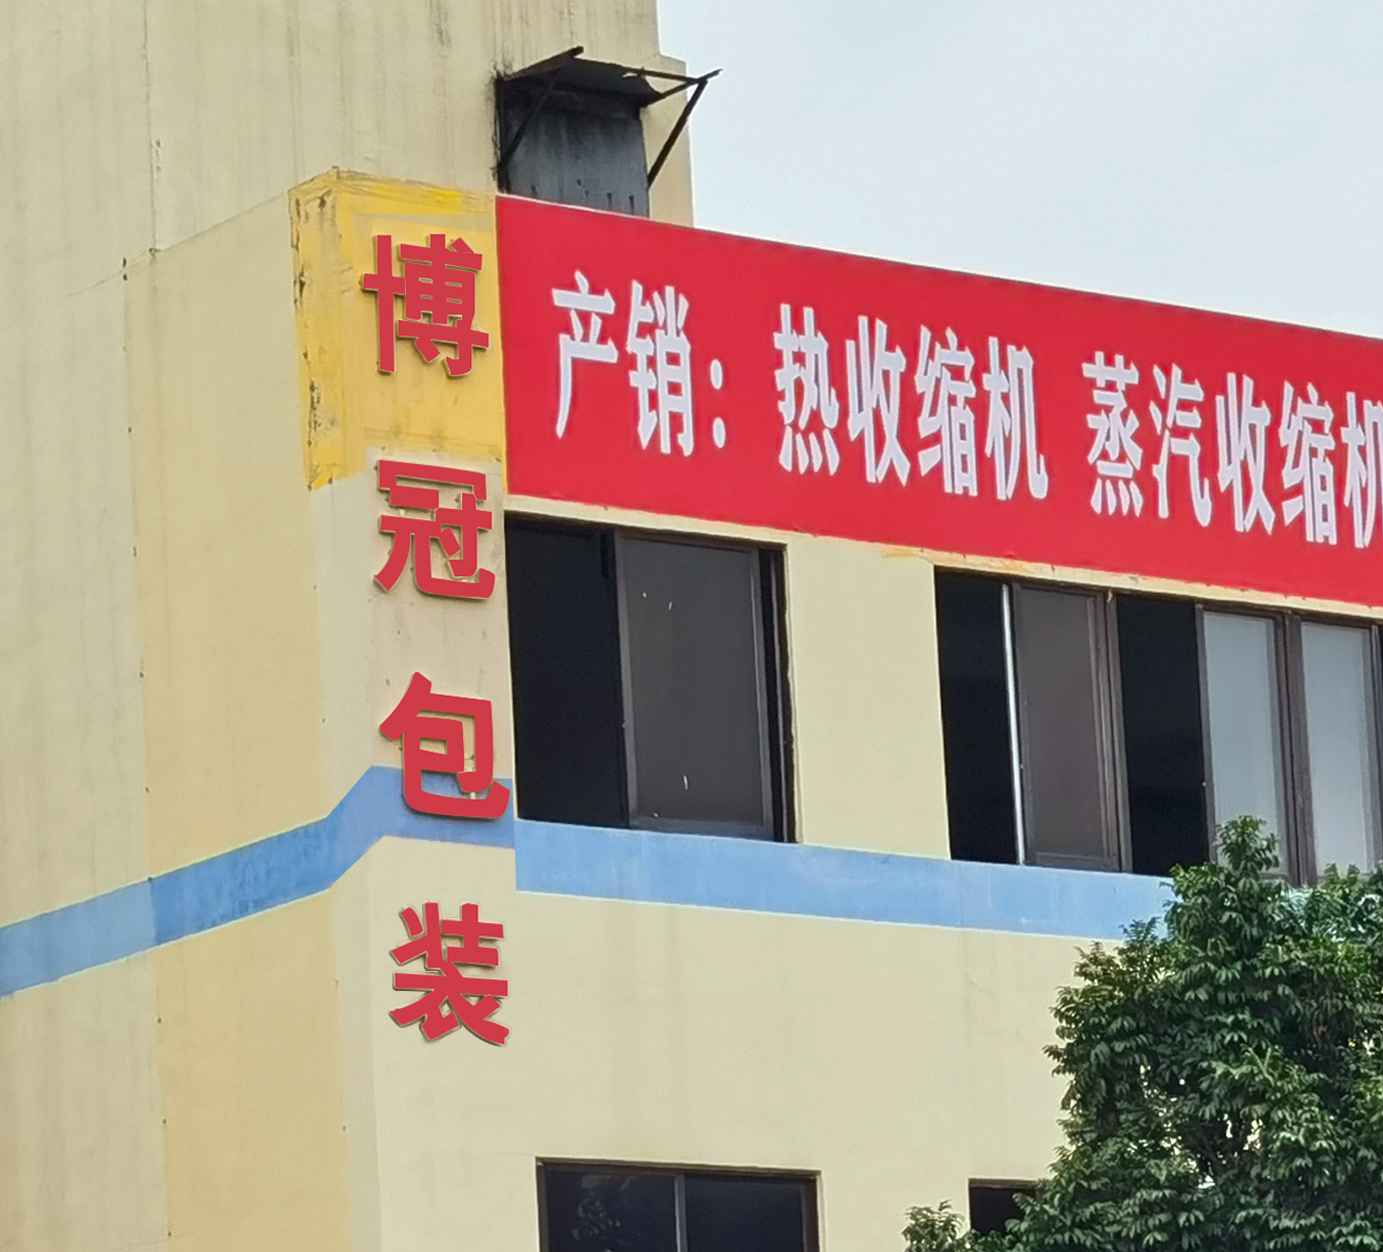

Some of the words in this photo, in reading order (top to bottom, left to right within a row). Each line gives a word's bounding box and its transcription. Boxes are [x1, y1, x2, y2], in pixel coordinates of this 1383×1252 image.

[361, 232, 511, 1046] 博冠包装
[771, 302, 1050, 502] 热收缩机
